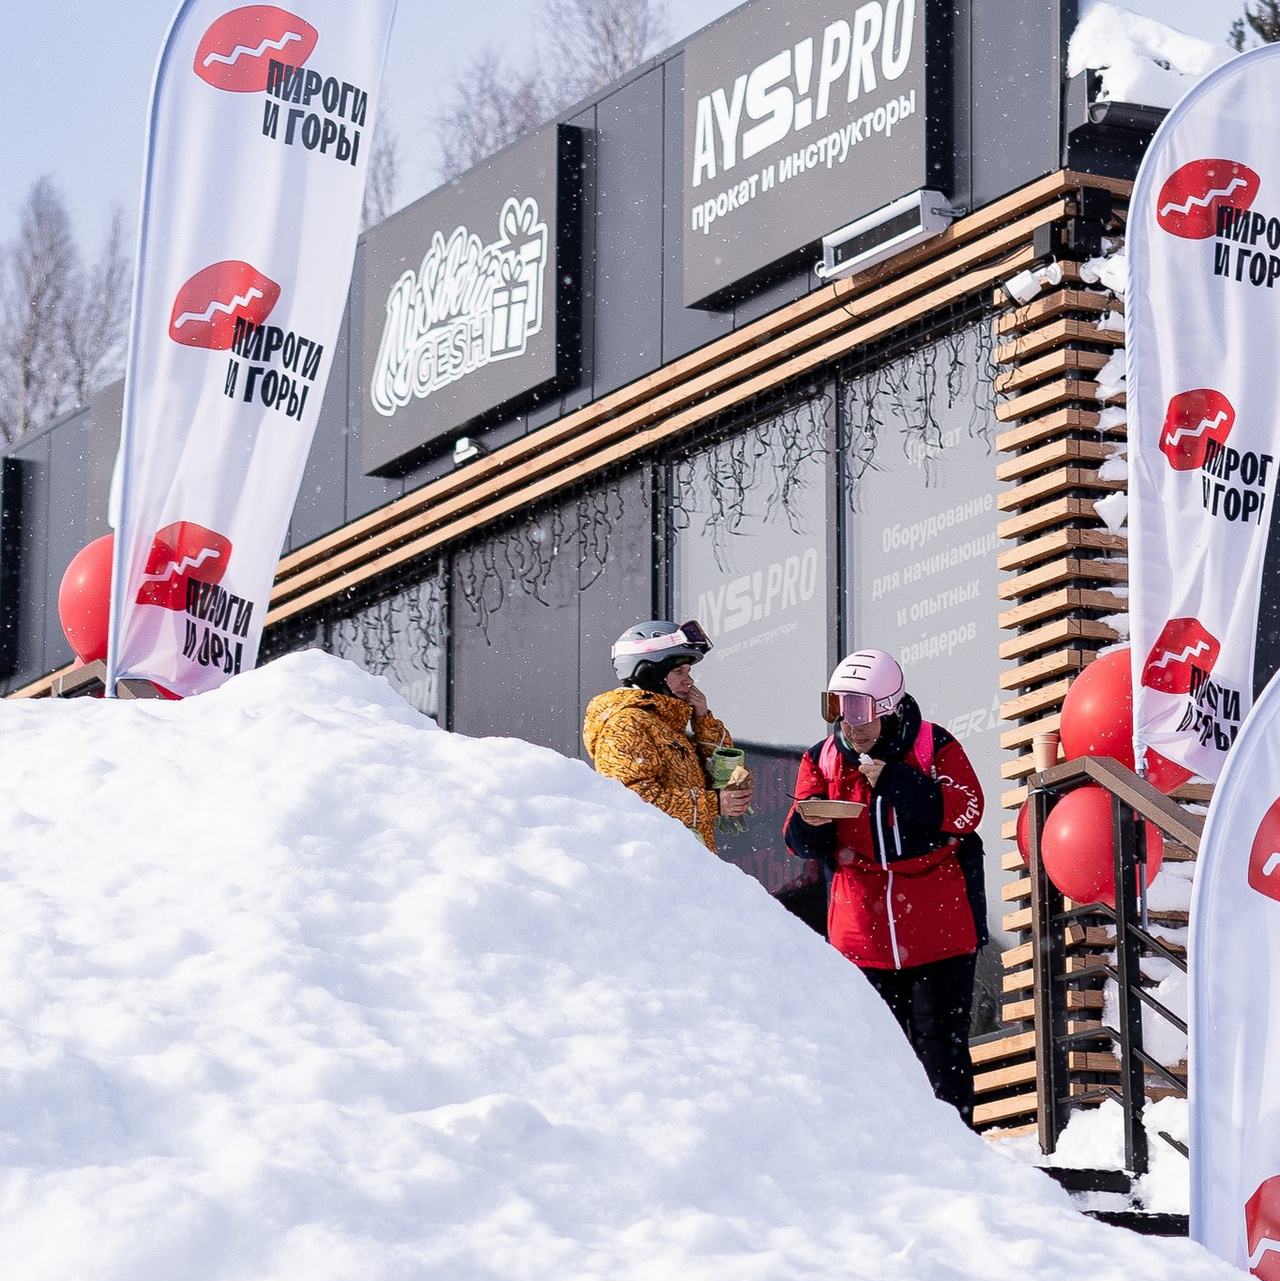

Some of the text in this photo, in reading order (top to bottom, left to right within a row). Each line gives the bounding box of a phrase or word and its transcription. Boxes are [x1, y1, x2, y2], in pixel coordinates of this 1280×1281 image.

[266, 58, 368, 127] ПИРОГИ
[262, 99, 360, 167] И ГОРЫ
[692, 89, 916, 235] прокат и инструкторы
[1214, 242, 1231, 278] И
[231, 315, 324, 382] ПИРОГИ
[224, 358, 310, 422] И ГОРЫ
[882, 493, 993, 553] Оборудование
[872, 571, 900, 602] для
[897, 579, 980, 627] и опытных
[901, 621, 977, 668] райдеров
